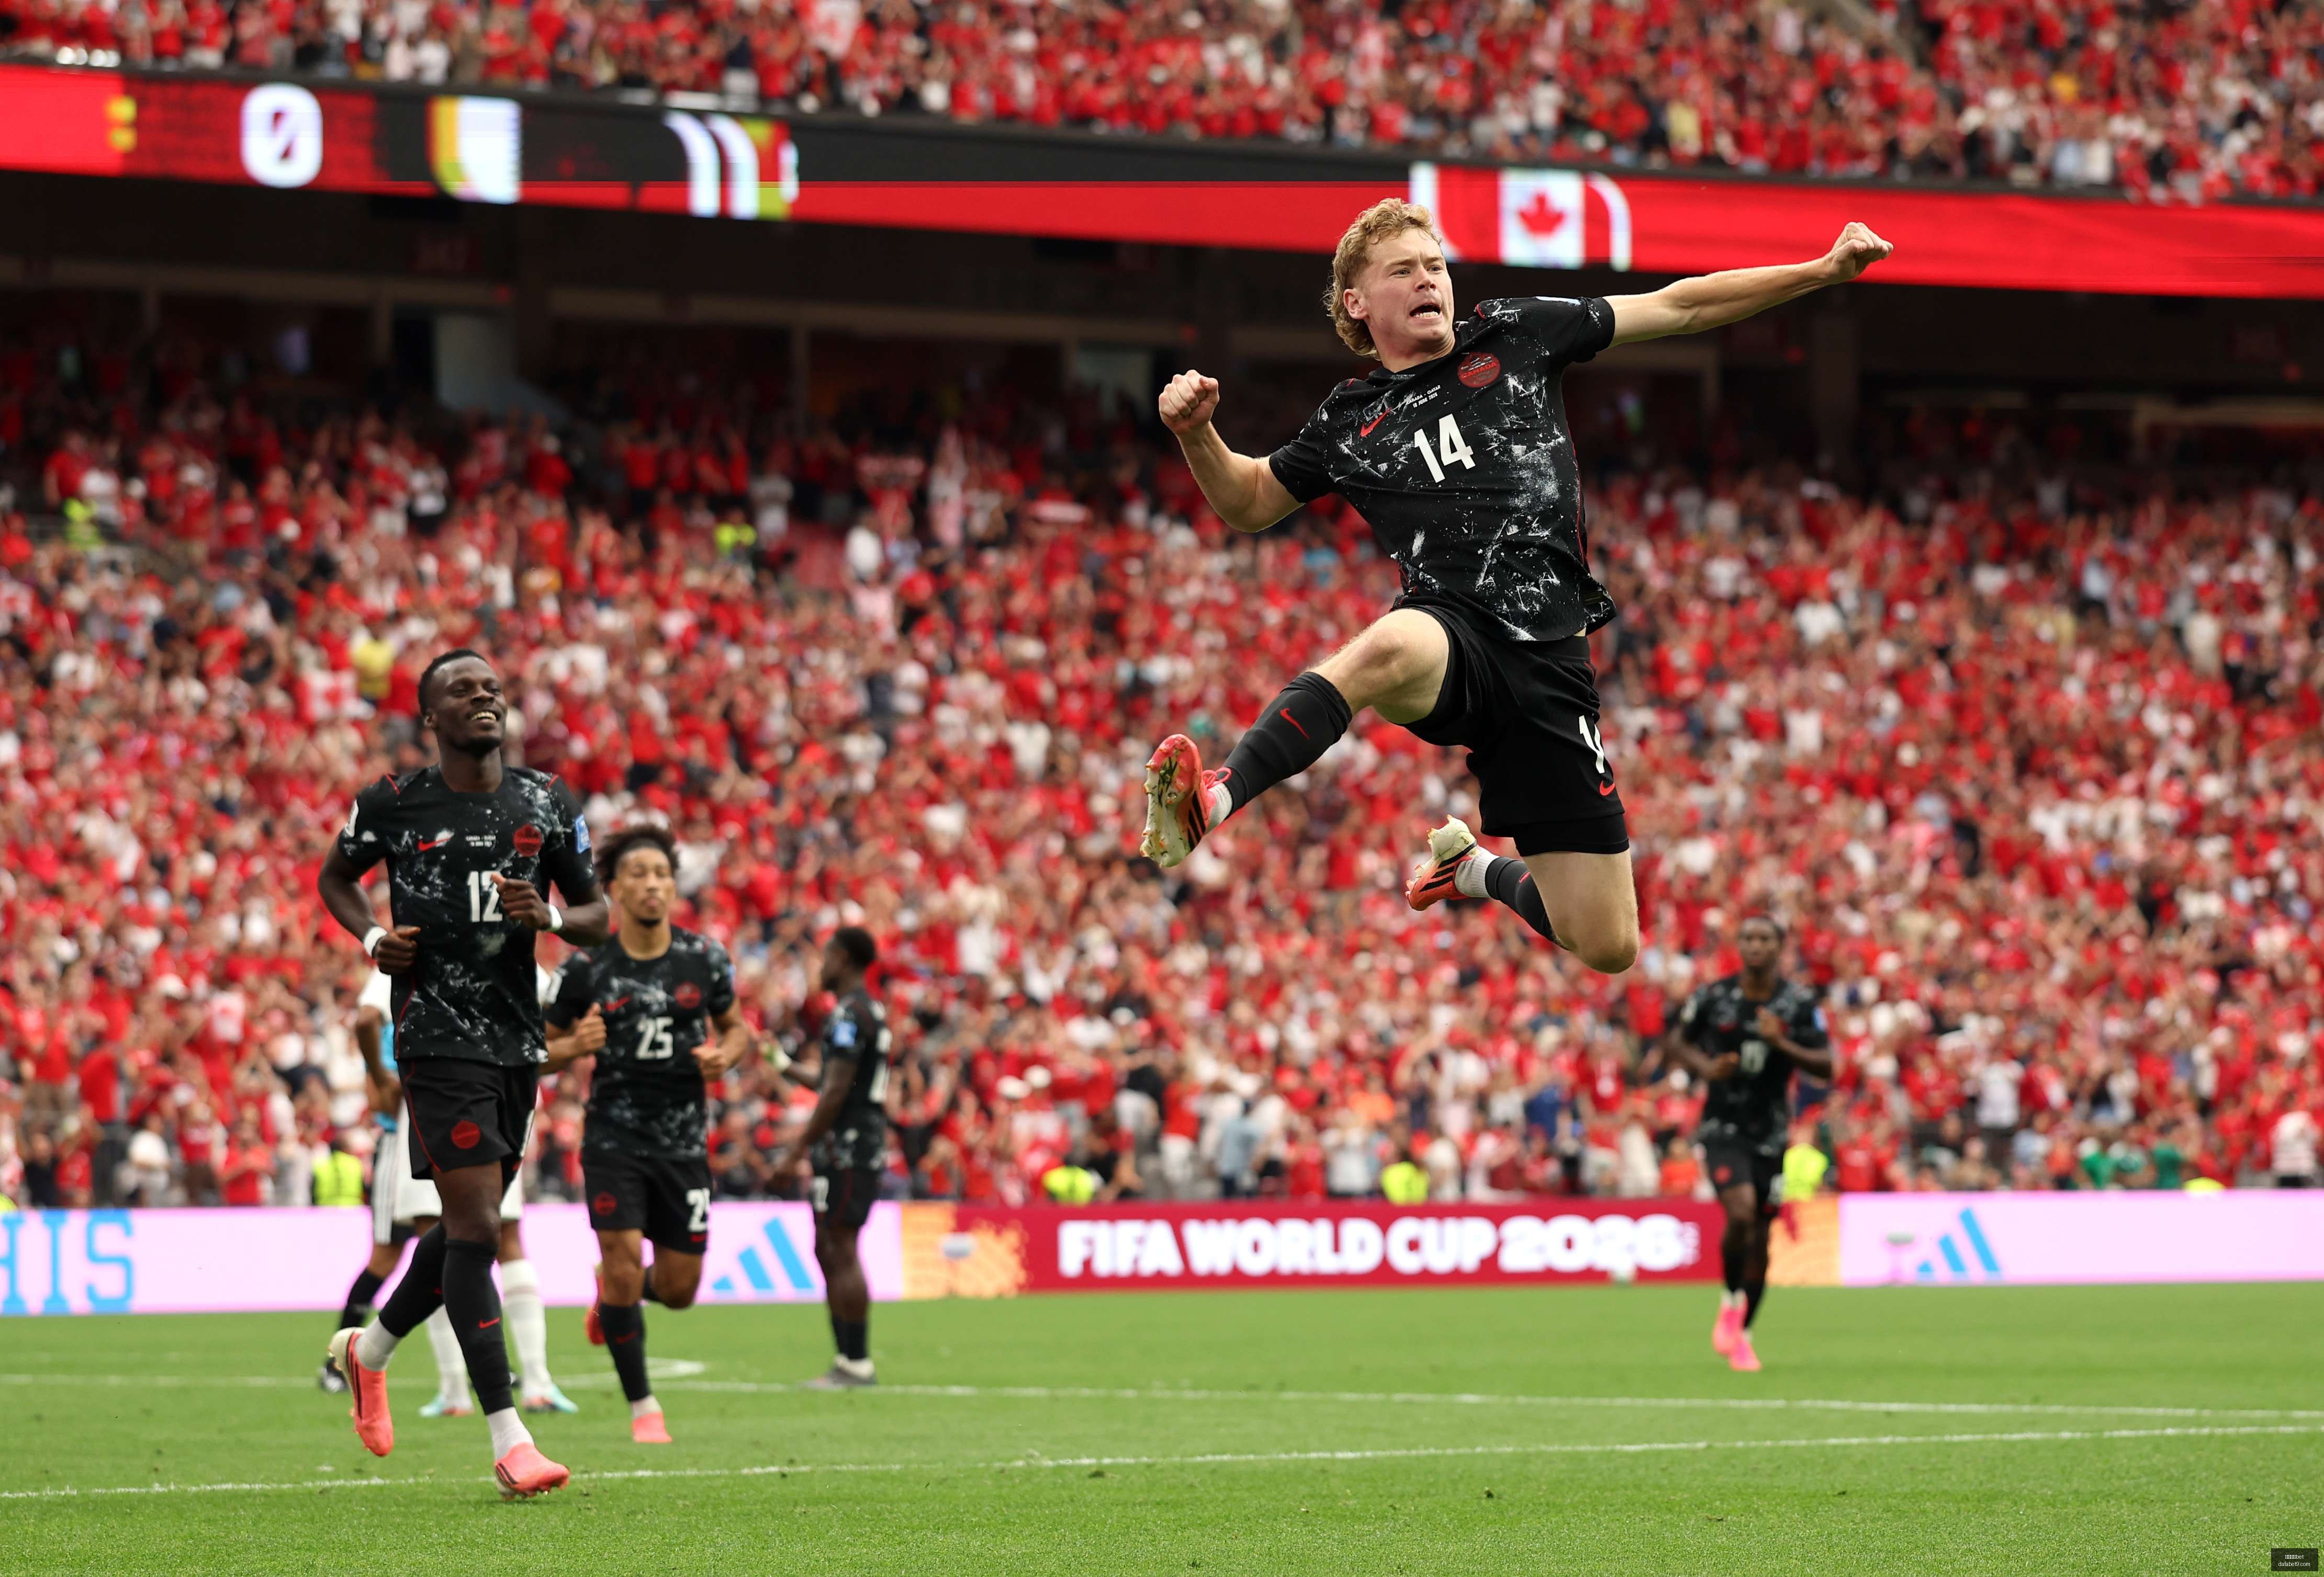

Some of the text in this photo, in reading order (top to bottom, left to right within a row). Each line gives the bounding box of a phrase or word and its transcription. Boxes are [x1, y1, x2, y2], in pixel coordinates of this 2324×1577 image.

[241, 82, 323, 188] 0
[1427, 385, 1441, 394] QATAR
[1462, 362, 1497, 378] CANADA
[1418, 397, 1428, 405] JUNE
[1414, 413, 1475, 483] 14
[467, 870, 503, 922] 12
[635, 1016, 674, 1060] 25
[686, 1187, 711, 1232] 2
[1058, 1219, 1184, 1278] FIFA
[1181, 1216, 1385, 1277] WORLD
[1385, 1215, 1498, 1275] CUP
[1498, 1213, 1685, 1274] 2026
